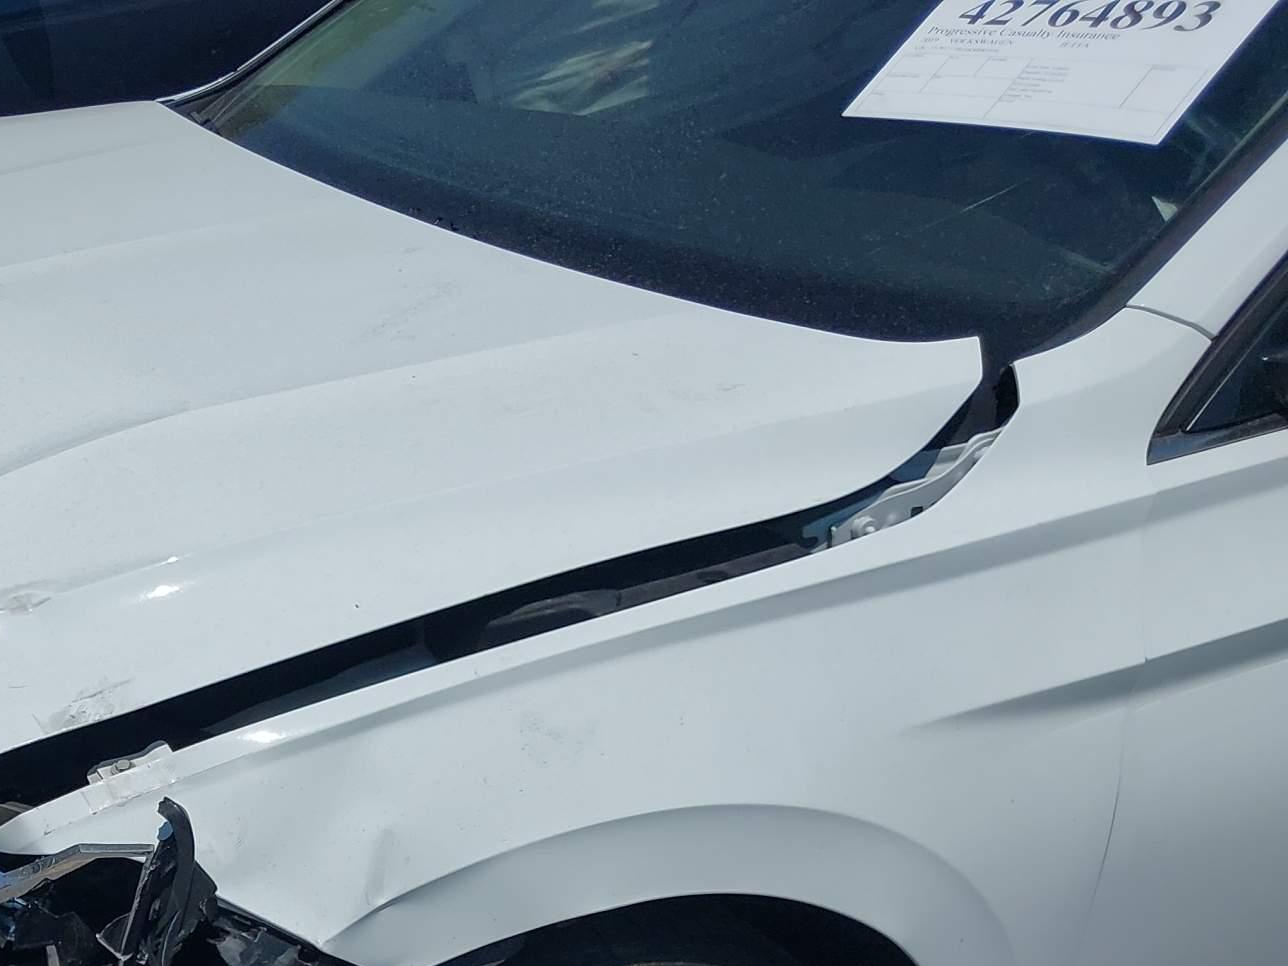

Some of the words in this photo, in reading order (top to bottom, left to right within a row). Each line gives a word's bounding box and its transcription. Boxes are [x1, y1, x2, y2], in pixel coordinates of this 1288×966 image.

[958, 0, 1222, 32] 42764893
[927, 26, 998, 37] Progressive
[999, 28, 1051, 40] Casualty
[1056, 29, 1121, 41] Insurance
